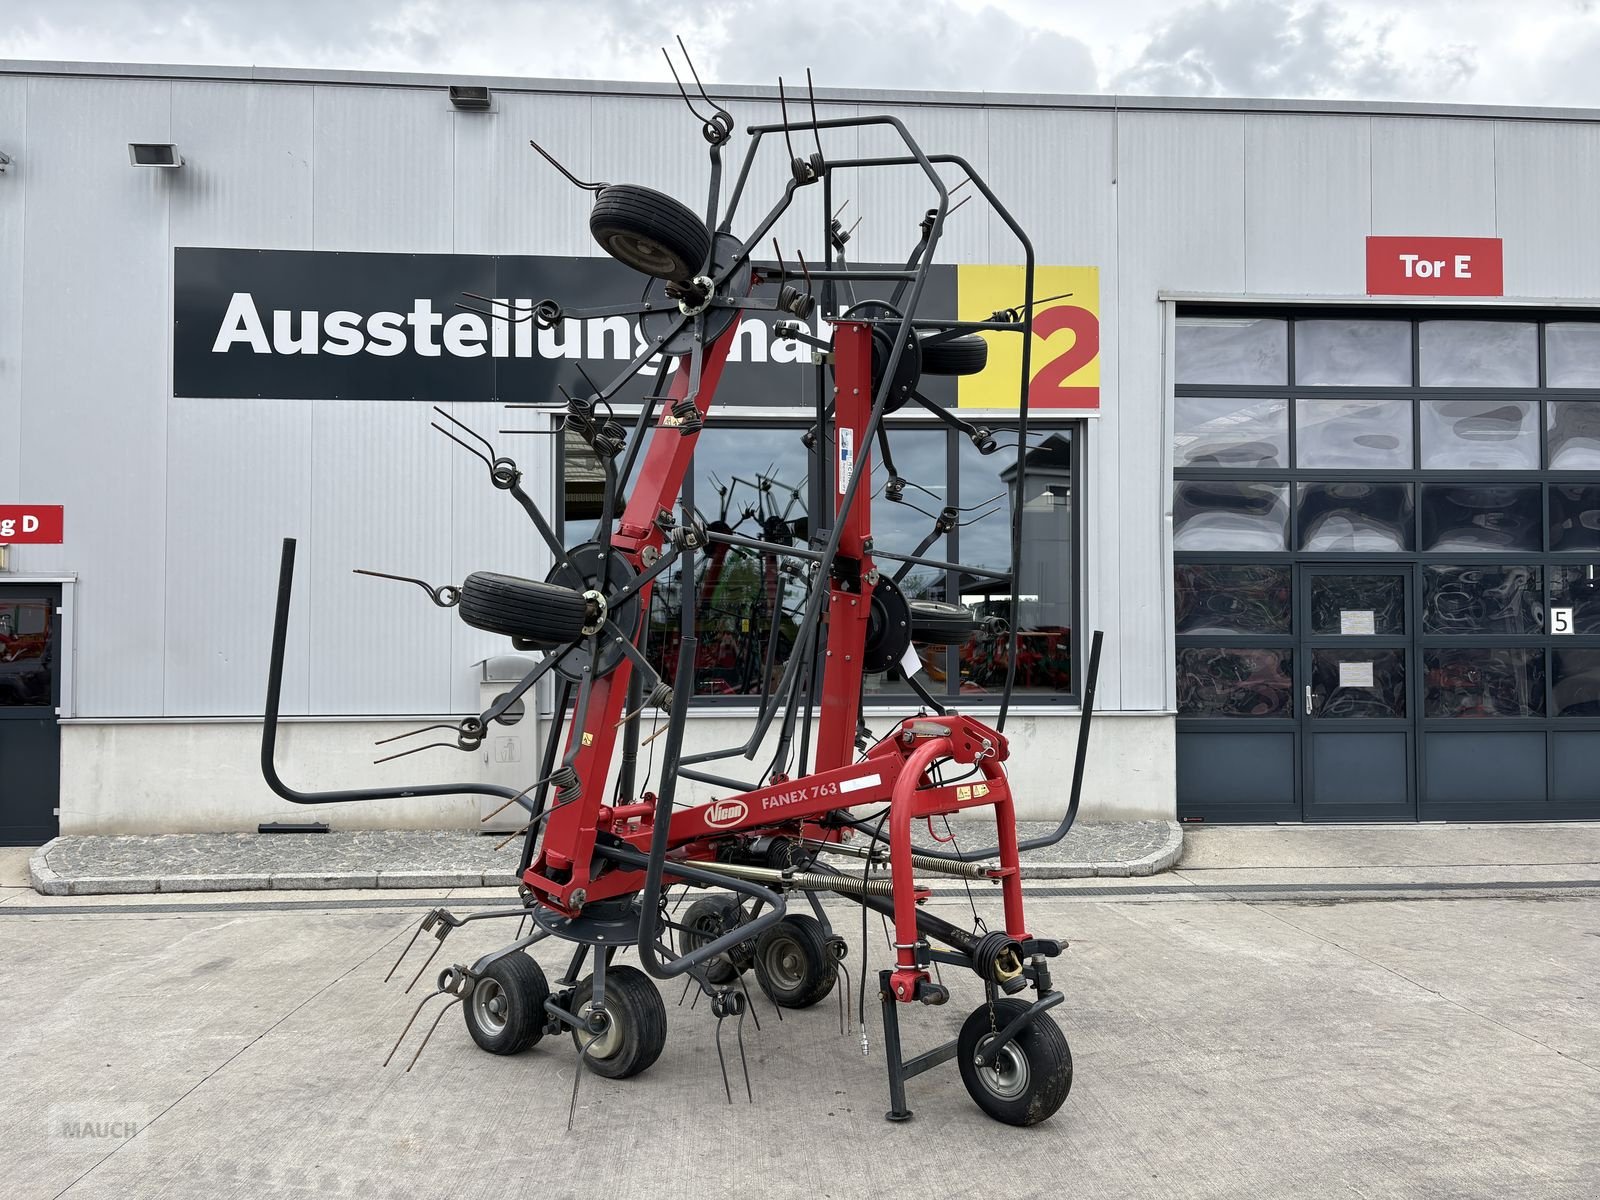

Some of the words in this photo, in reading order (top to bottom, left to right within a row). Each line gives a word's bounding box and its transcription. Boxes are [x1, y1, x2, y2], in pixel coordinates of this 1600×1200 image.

[1399, 254, 1446, 278] Tor
[1454, 255, 1472, 278] E
[211, 292, 896, 376] Ausstellunghal
[1026, 305, 1100, 409] 2
[22, 515, 39, 533] D
[1555, 611, 1568, 632] 5
[761, 789, 809, 810] FANEX
[810, 782, 837, 799] 763
[709, 803, 743, 823] Vicon
